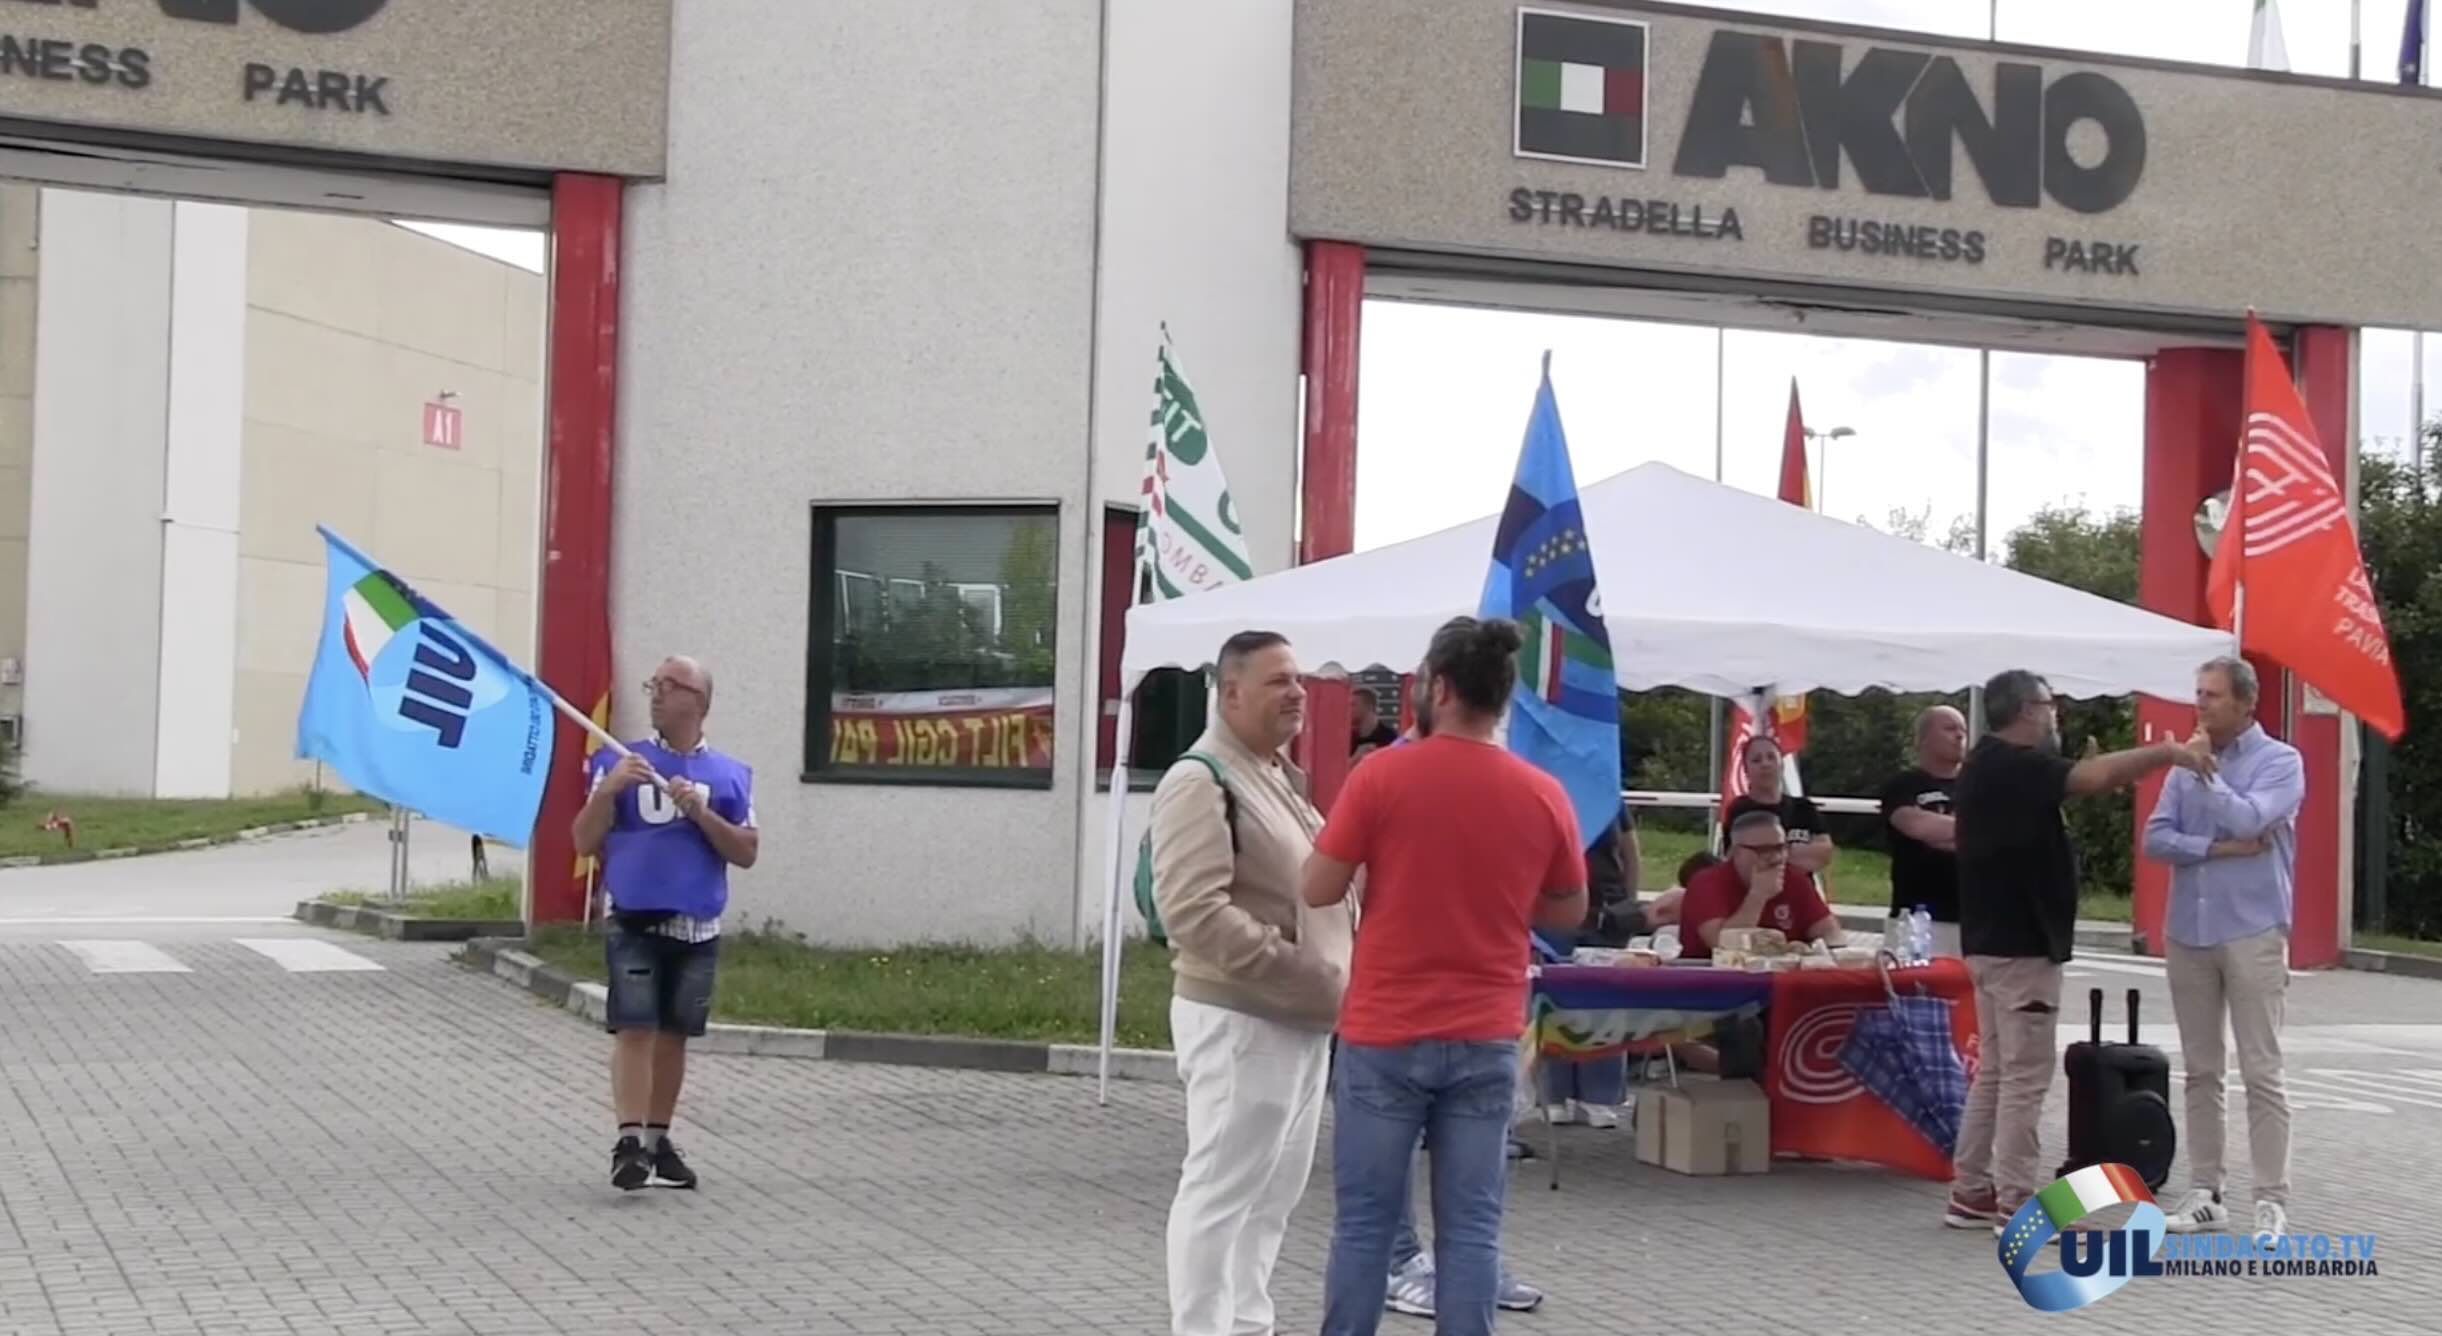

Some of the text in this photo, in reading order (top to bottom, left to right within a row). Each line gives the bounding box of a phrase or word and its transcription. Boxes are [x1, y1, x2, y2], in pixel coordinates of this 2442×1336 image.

[0, 34, 390, 115] NESS PARK
[1672, 30, 2147, 214] AKNO
[1508, 187, 2141, 276] STRADELLA BUSINESS PARK
[432, 409, 453, 444] A1
